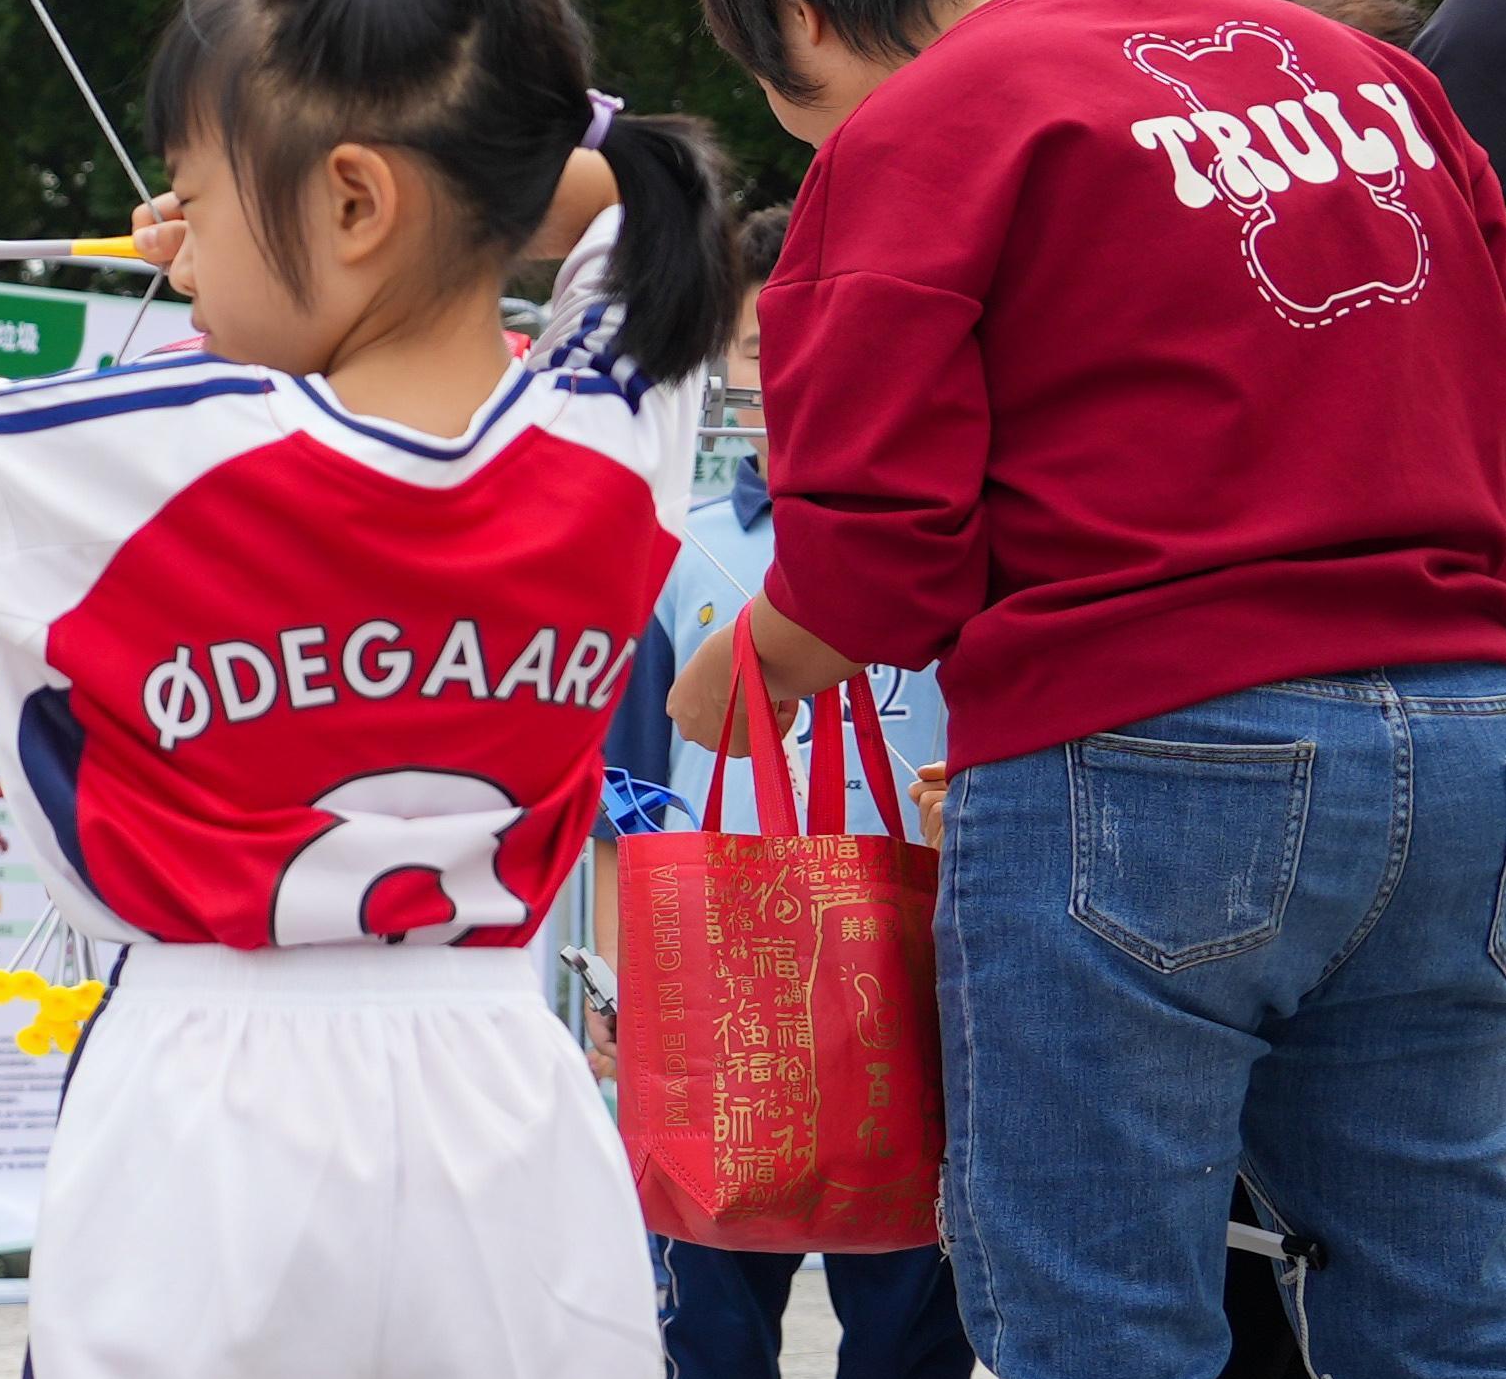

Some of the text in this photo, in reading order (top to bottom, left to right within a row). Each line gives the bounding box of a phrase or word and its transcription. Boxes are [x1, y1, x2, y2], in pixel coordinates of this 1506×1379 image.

[1131, 83, 1436, 209] TRULY
[649, 863, 690, 1126] MADE IN CHINA
[726, 1052, 775, 1083] 福
